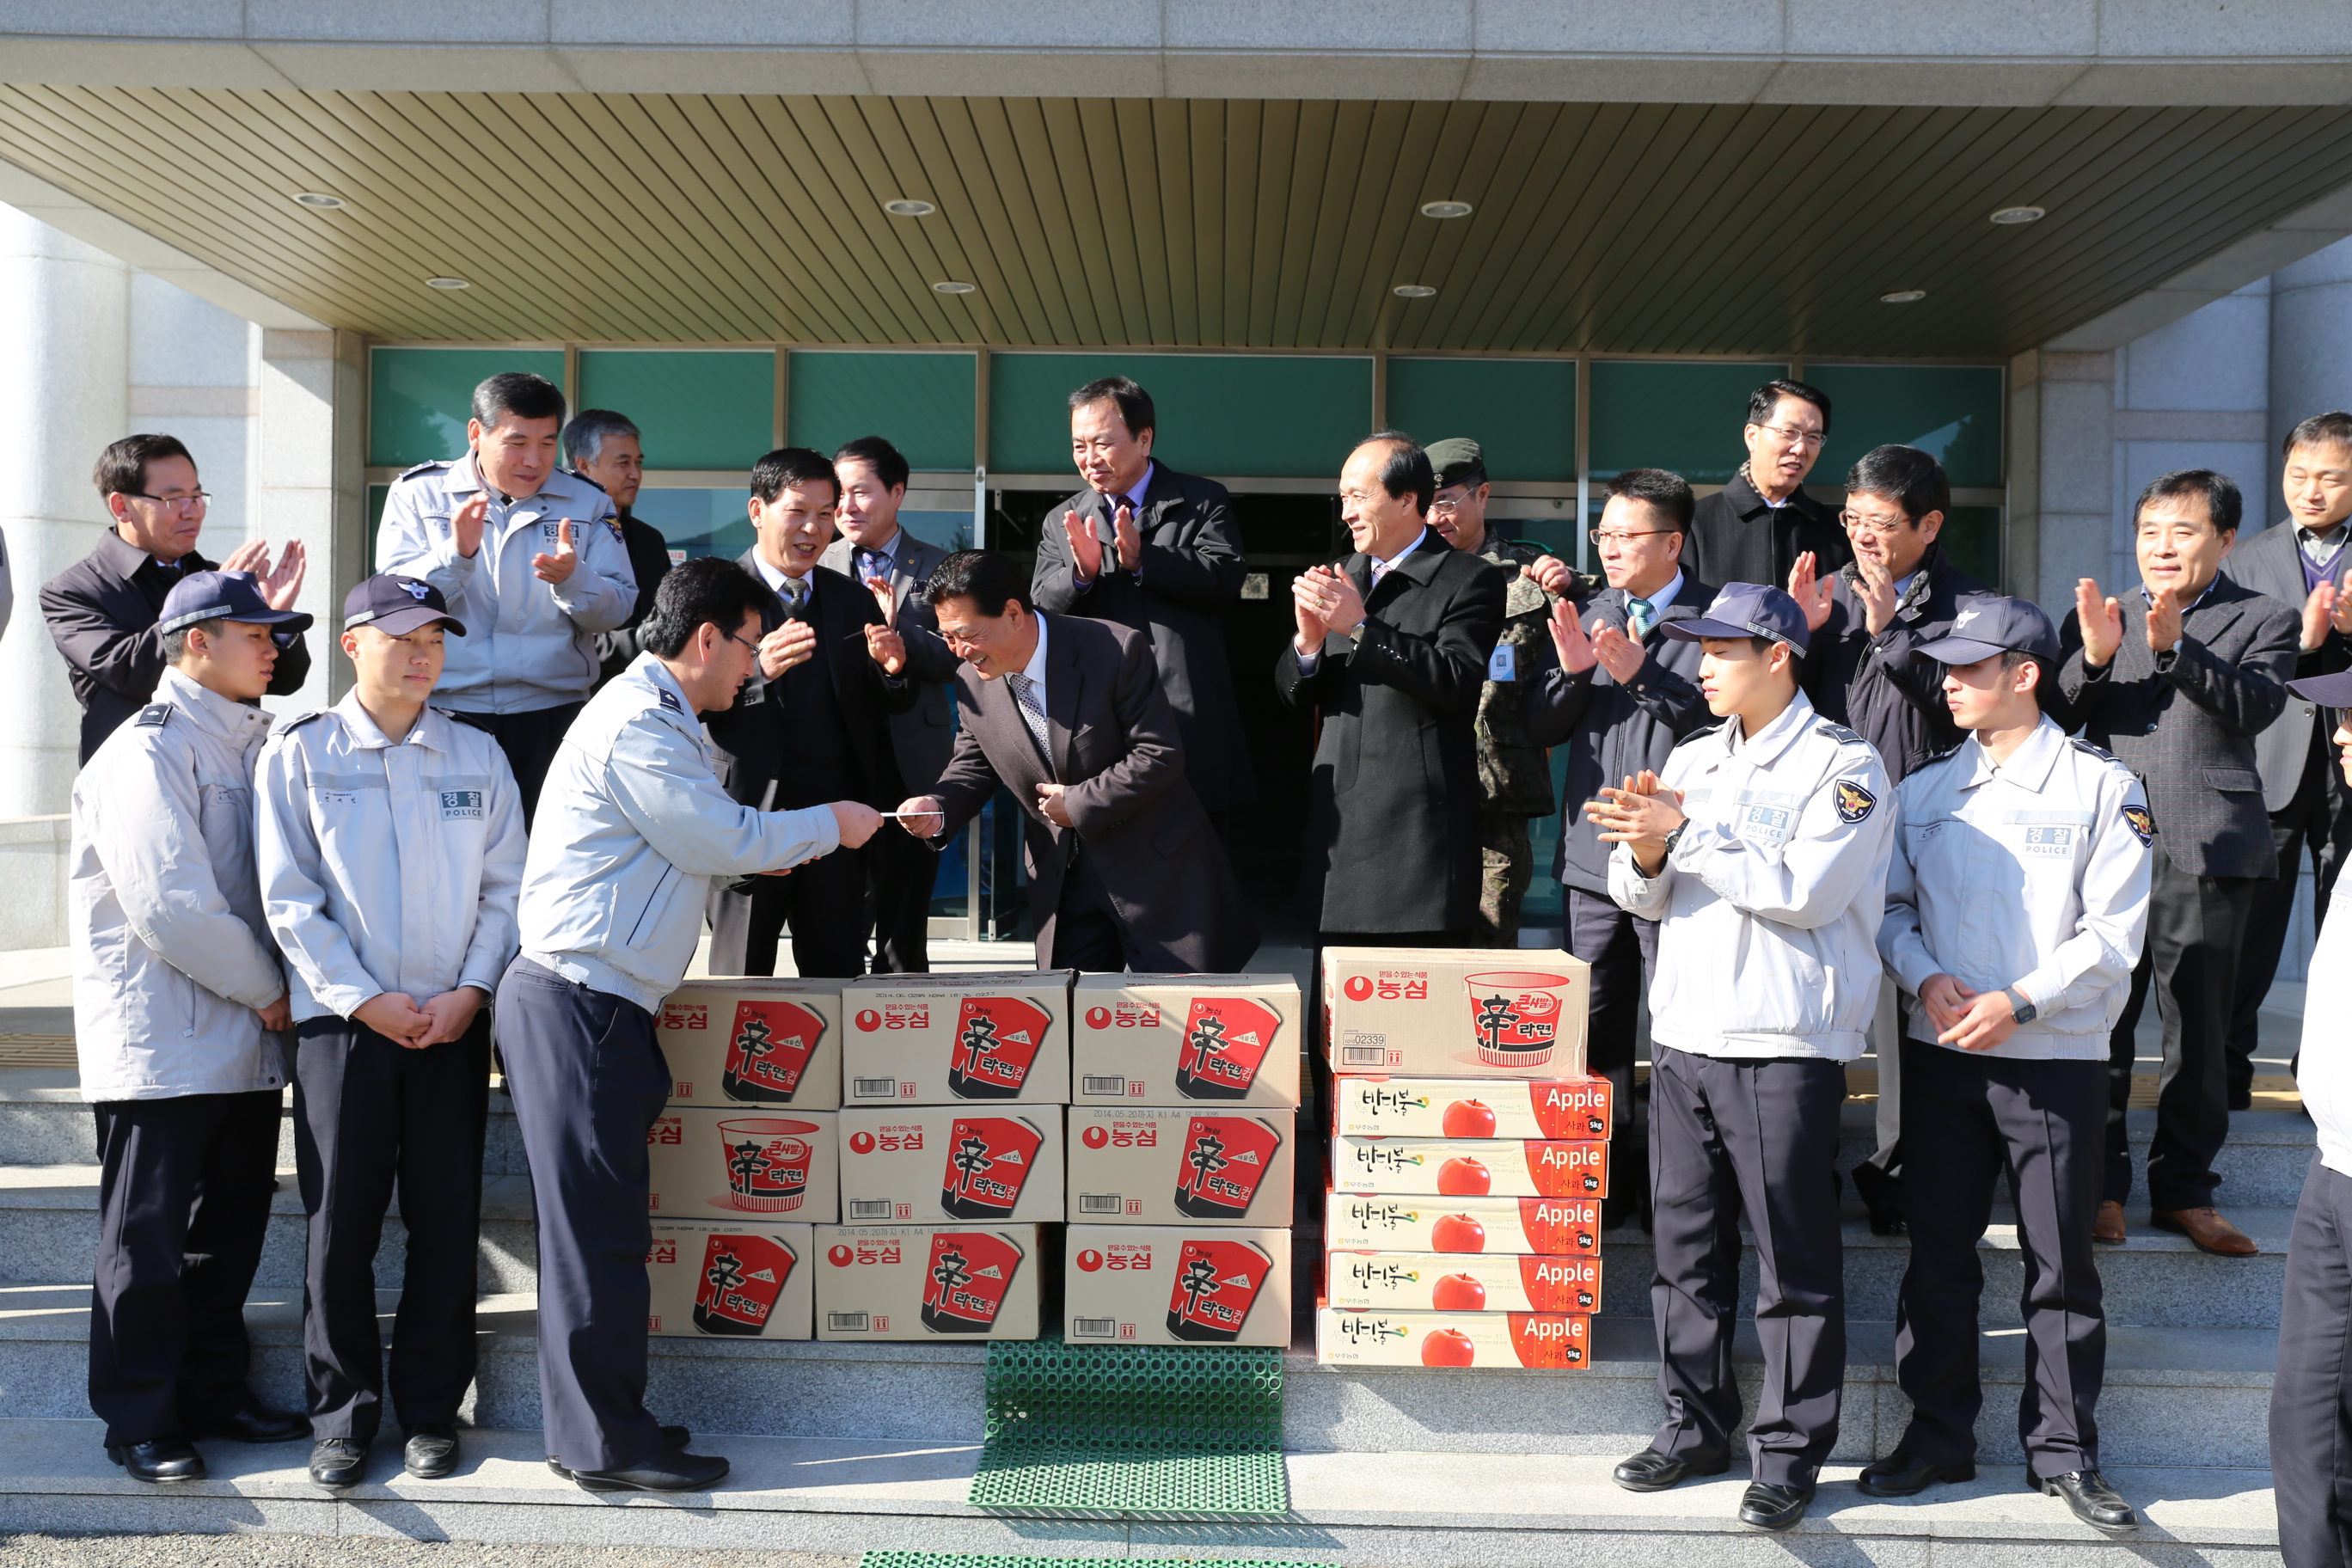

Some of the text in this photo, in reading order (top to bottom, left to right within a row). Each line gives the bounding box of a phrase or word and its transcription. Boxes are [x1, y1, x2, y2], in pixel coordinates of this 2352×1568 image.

[444, 792, 481, 808] 경찰
[1750, 806, 1786, 829] 경찰
[1746, 824, 1782, 838] POLICE
[2029, 828, 2069, 844] 경찰
[2026, 846, 2067, 854] POLICE
[1377, 979, 1428, 1000] 농심
[664, 1011, 707, 1030] 농심
[885, 1012, 929, 1029] 농심
[1115, 1009, 1161, 1028] 농심
[1478, 994, 1519, 1050] 辛
[1519, 1024, 1552, 1037] 라면
[737, 1020, 775, 1074] 辛
[962, 1016, 1001, 1071] 辛
[1191, 1016, 1229, 1071] 辛
[1547, 1088, 1605, 1112] Apple
[1565, 1121, 1602, 1131] 사과 5kg
[879, 1133, 923, 1151] 농심
[1112, 1129, 1157, 1147] 농심
[731, 1140, 771, 1195] 辛
[954, 1136, 992, 1191] 辛
[1190, 1136, 1228, 1191] 辛
[1540, 1146, 1601, 1170] Apple
[770, 1169, 803, 1183] 라면
[1560, 1179, 1597, 1190] 사과 5kg
[1535, 1204, 1595, 1227] Apple
[1554, 1236, 1592, 1246] 사과 5kg
[856, 1246, 901, 1265] 농심
[1106, 1252, 1151, 1271] 농심
[708, 1253, 745, 1307] 辛
[934, 1252, 972, 1306] 辛
[1535, 1263, 1595, 1286] Apple
[1181, 1259, 1220, 1313] 辛
[1555, 1295, 1592, 1306] 사과 5kg
[1524, 1318, 1583, 1341] Apple
[1544, 1350, 1580, 1361] 사과 5kg
